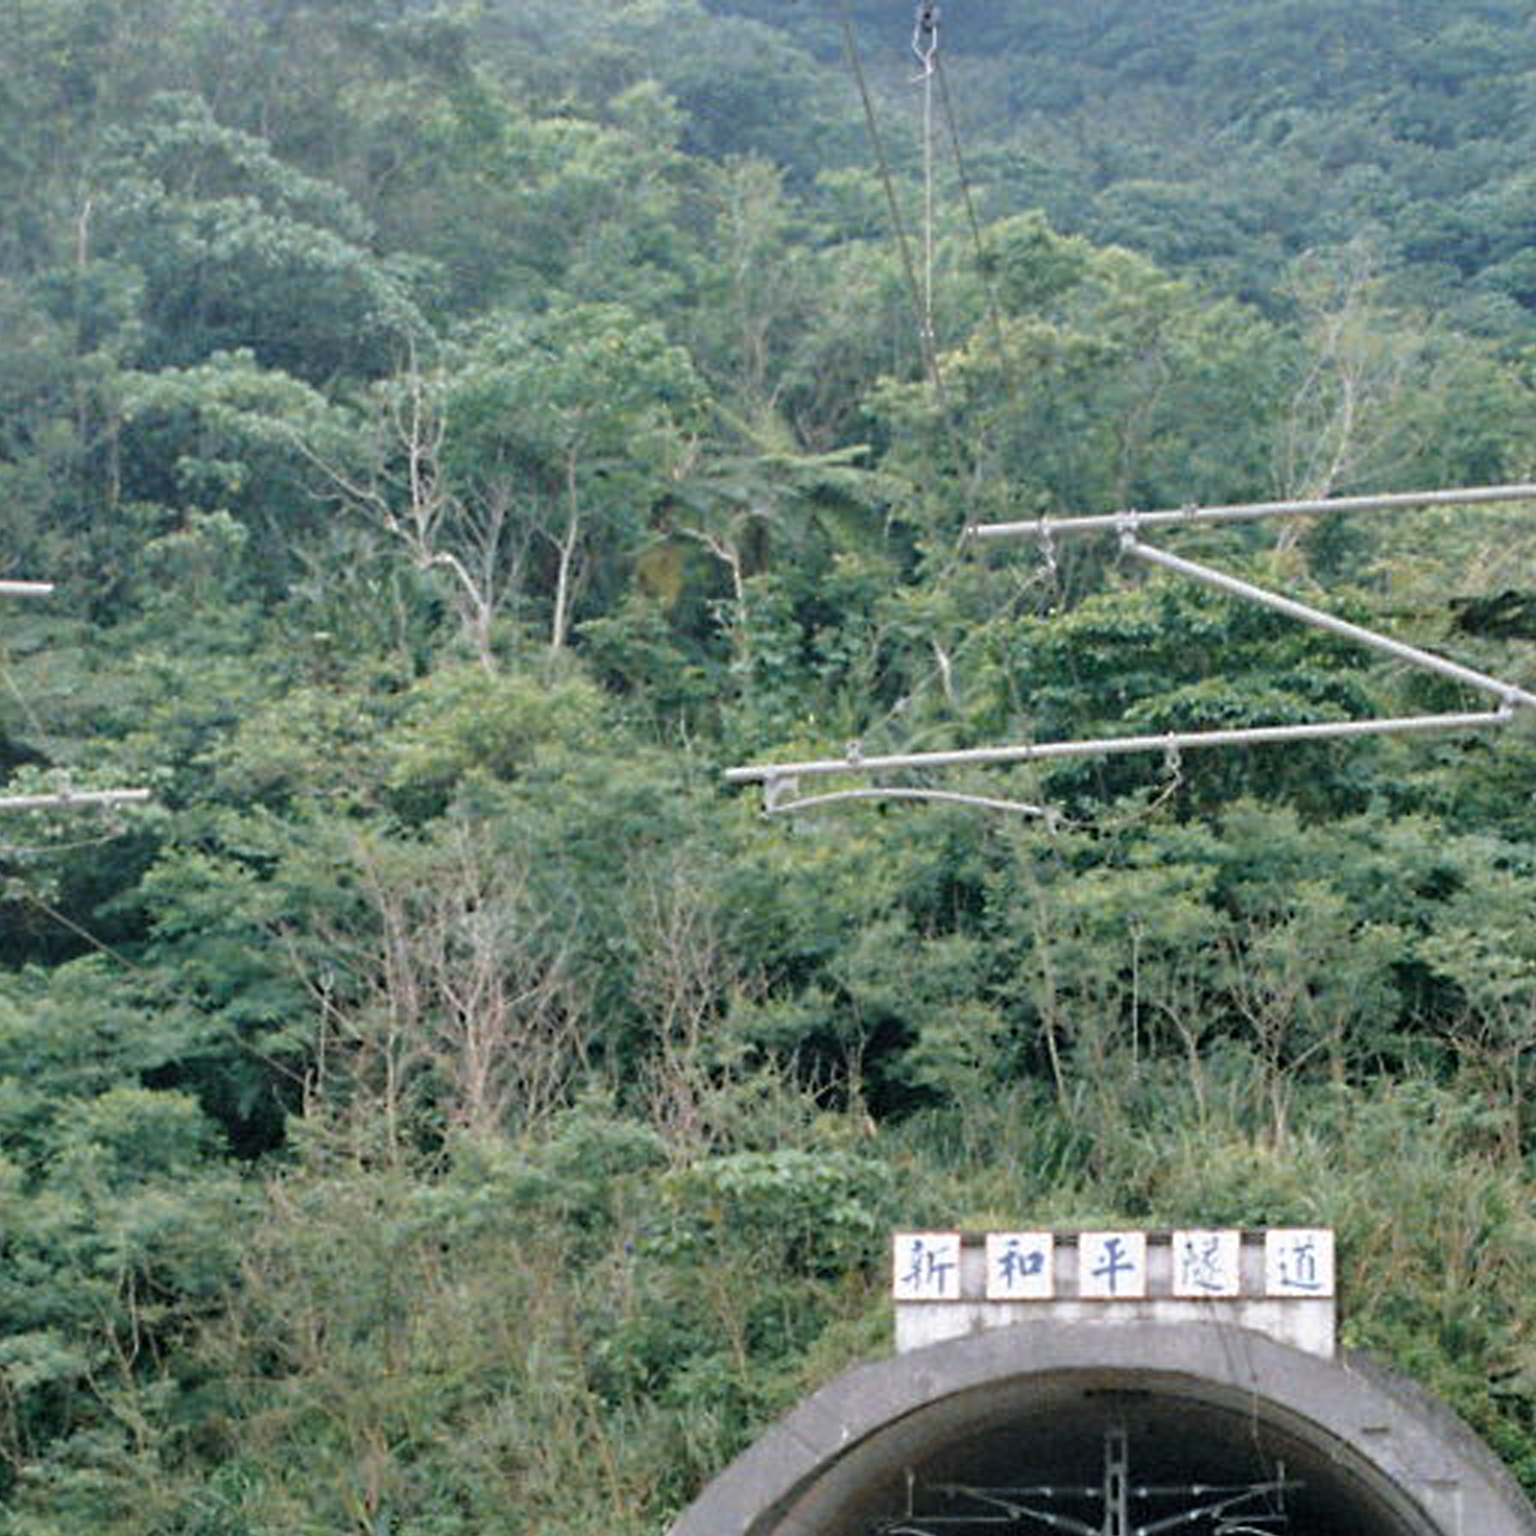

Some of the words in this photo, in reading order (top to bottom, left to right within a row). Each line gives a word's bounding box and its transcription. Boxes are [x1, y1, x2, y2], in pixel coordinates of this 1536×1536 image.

[901, 1236, 1322, 1293] 新和平隧道
